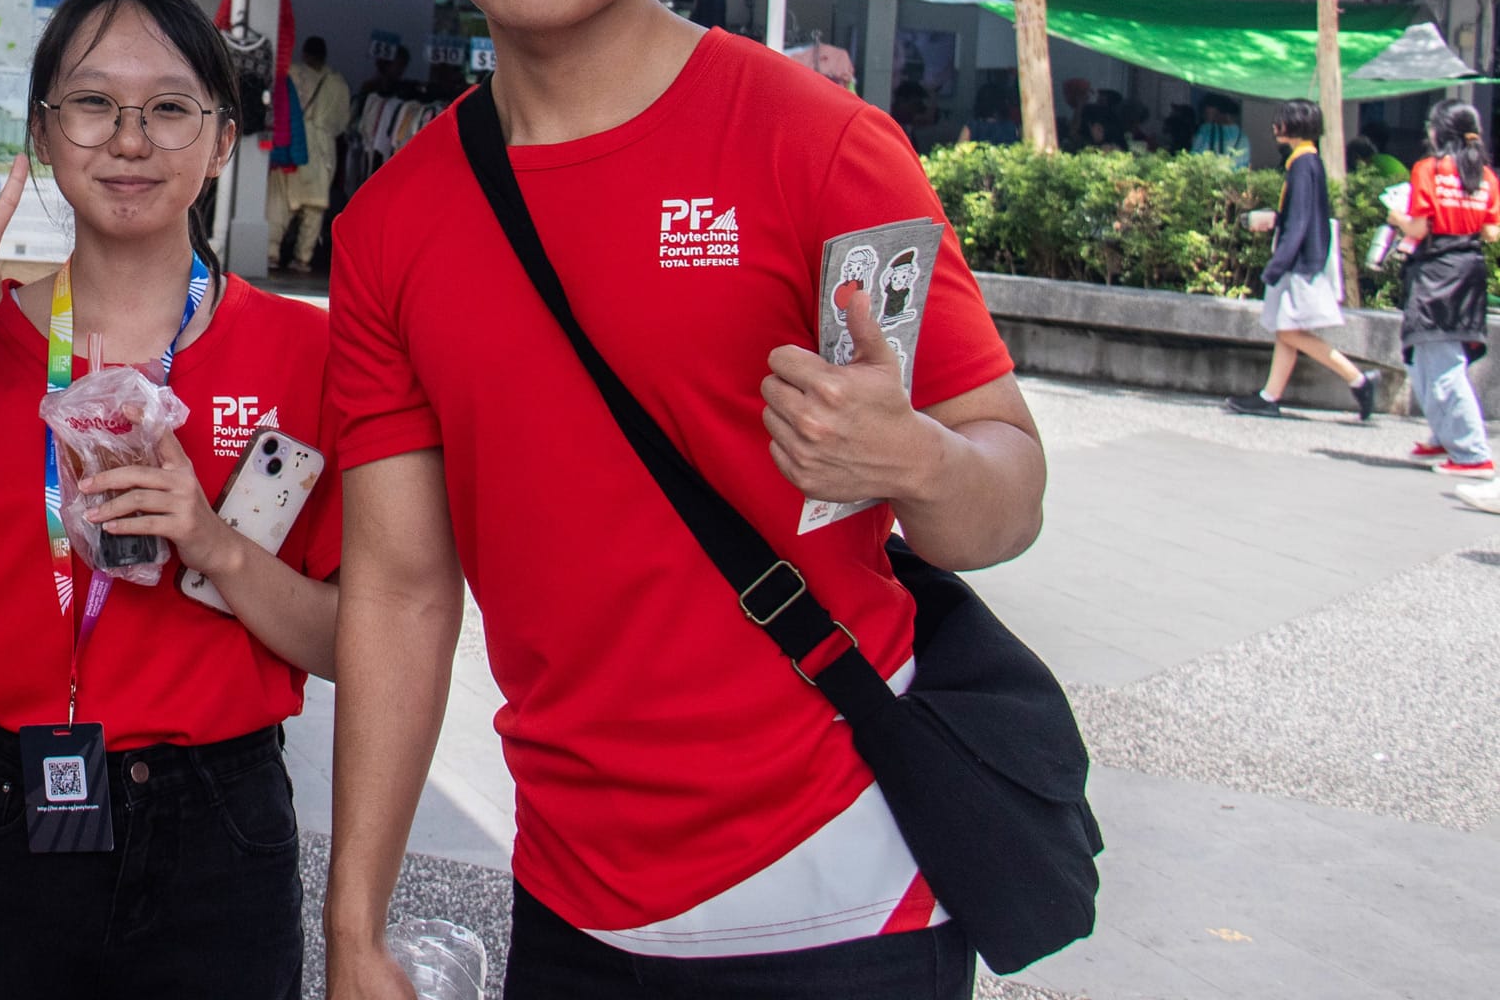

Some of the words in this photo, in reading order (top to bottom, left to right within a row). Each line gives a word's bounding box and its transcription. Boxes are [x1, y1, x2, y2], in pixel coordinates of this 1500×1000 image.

[660, 231, 739, 245] Polytechnic
[660, 246, 703, 257] Forum
[707, 244, 739, 255] 2024
[660, 260, 690, 268] TOTAL
[693, 258, 739, 267] DEFENCE
[213, 449, 240, 457] TOTAL
